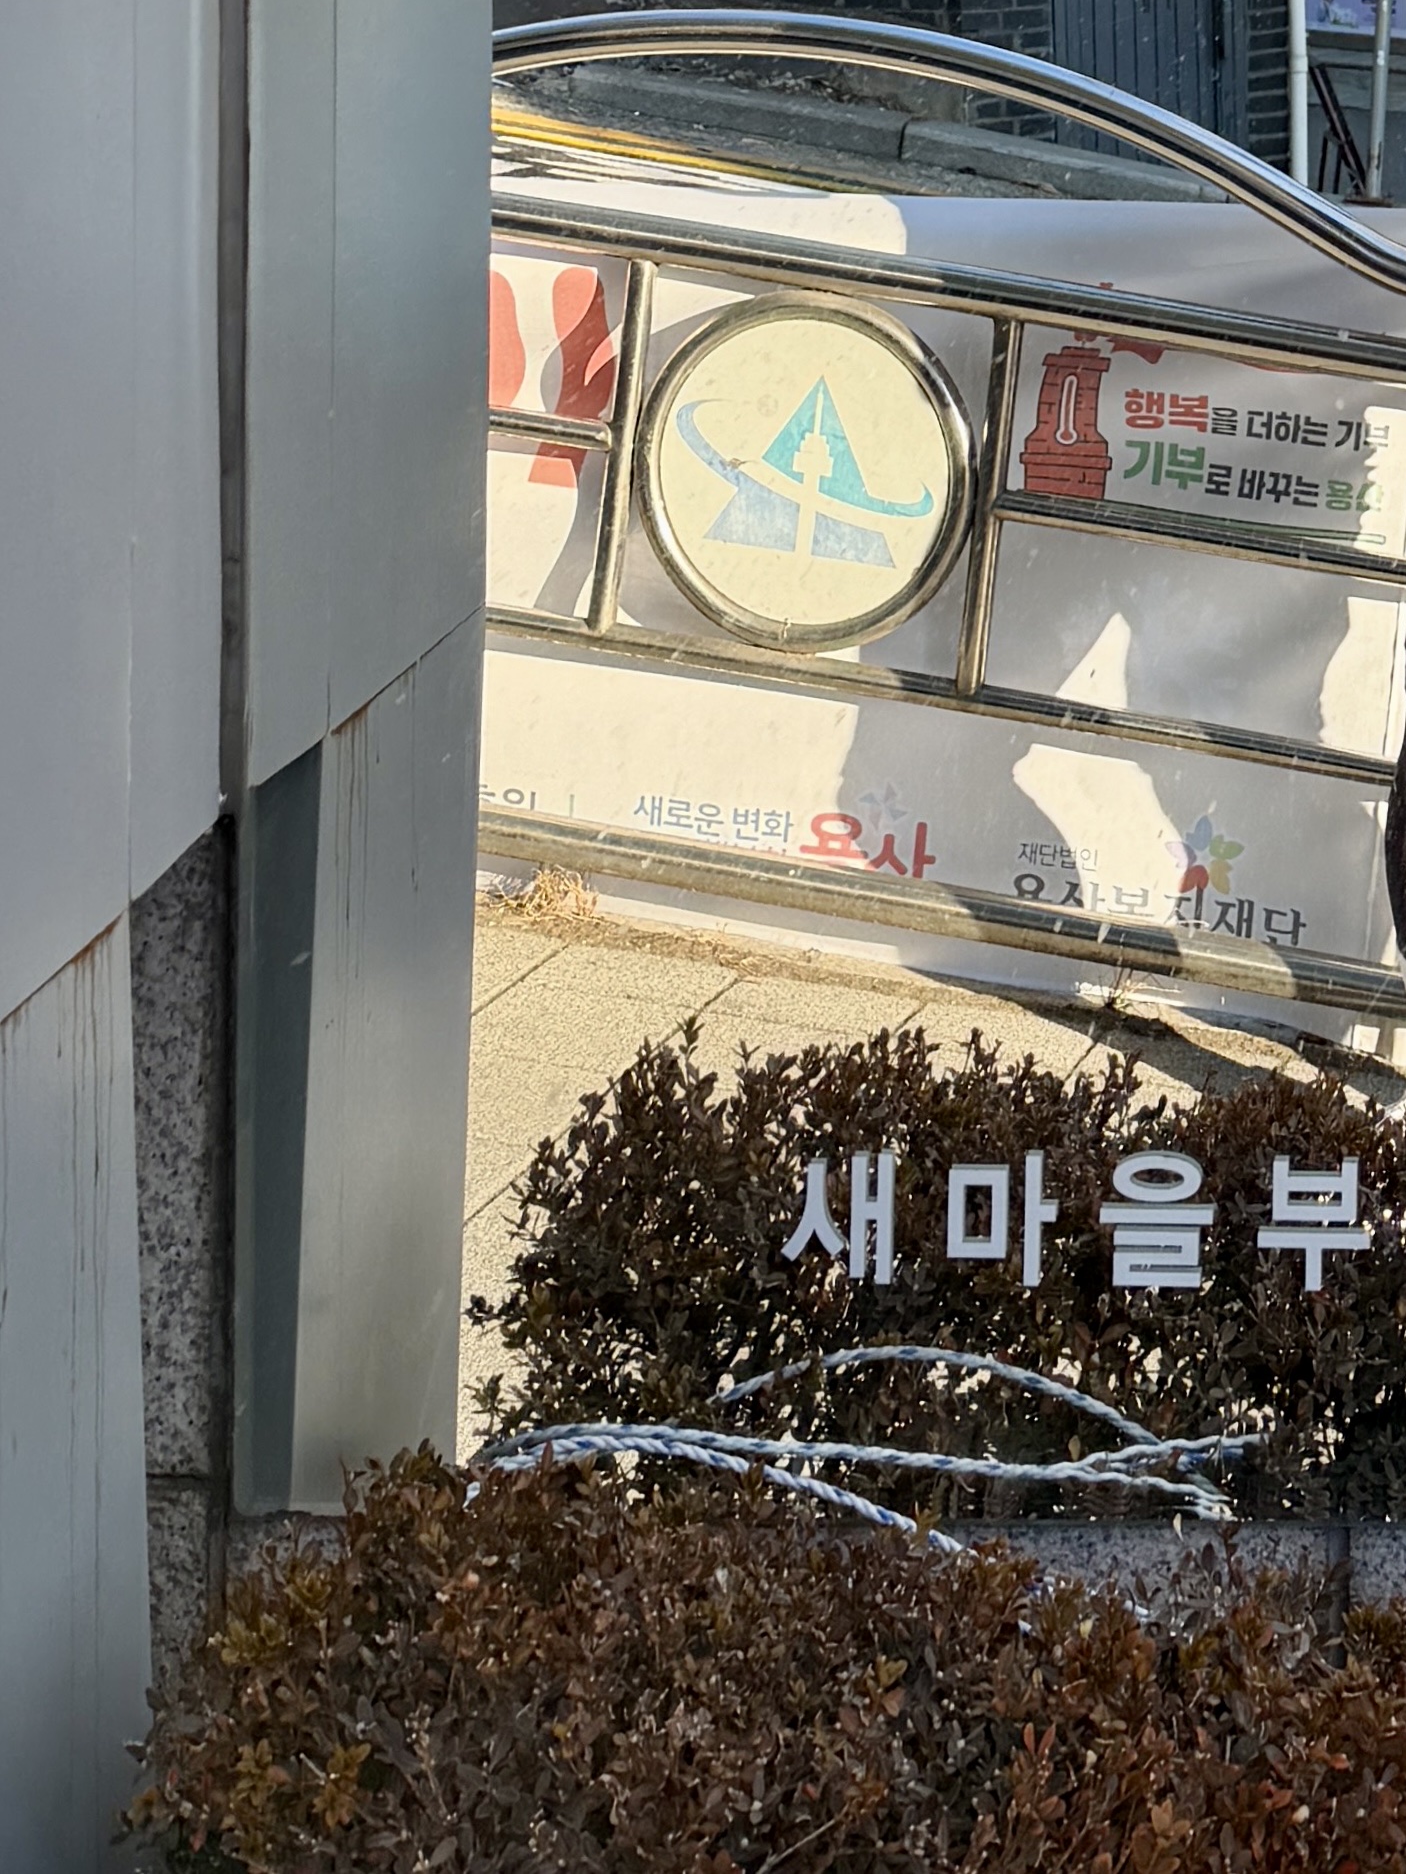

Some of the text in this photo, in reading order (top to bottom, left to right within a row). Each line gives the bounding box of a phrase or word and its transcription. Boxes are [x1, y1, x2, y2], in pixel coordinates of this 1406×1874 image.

[1122, 387, 1390, 452] 행복을 더하는 기부
[1122, 439, 1233, 497] 기부로
[1237, 465, 1321, 509] 바꾸는
[632, 793, 794, 844] 새로운 변화
[1017, 841, 1099, 872] 재단법인
